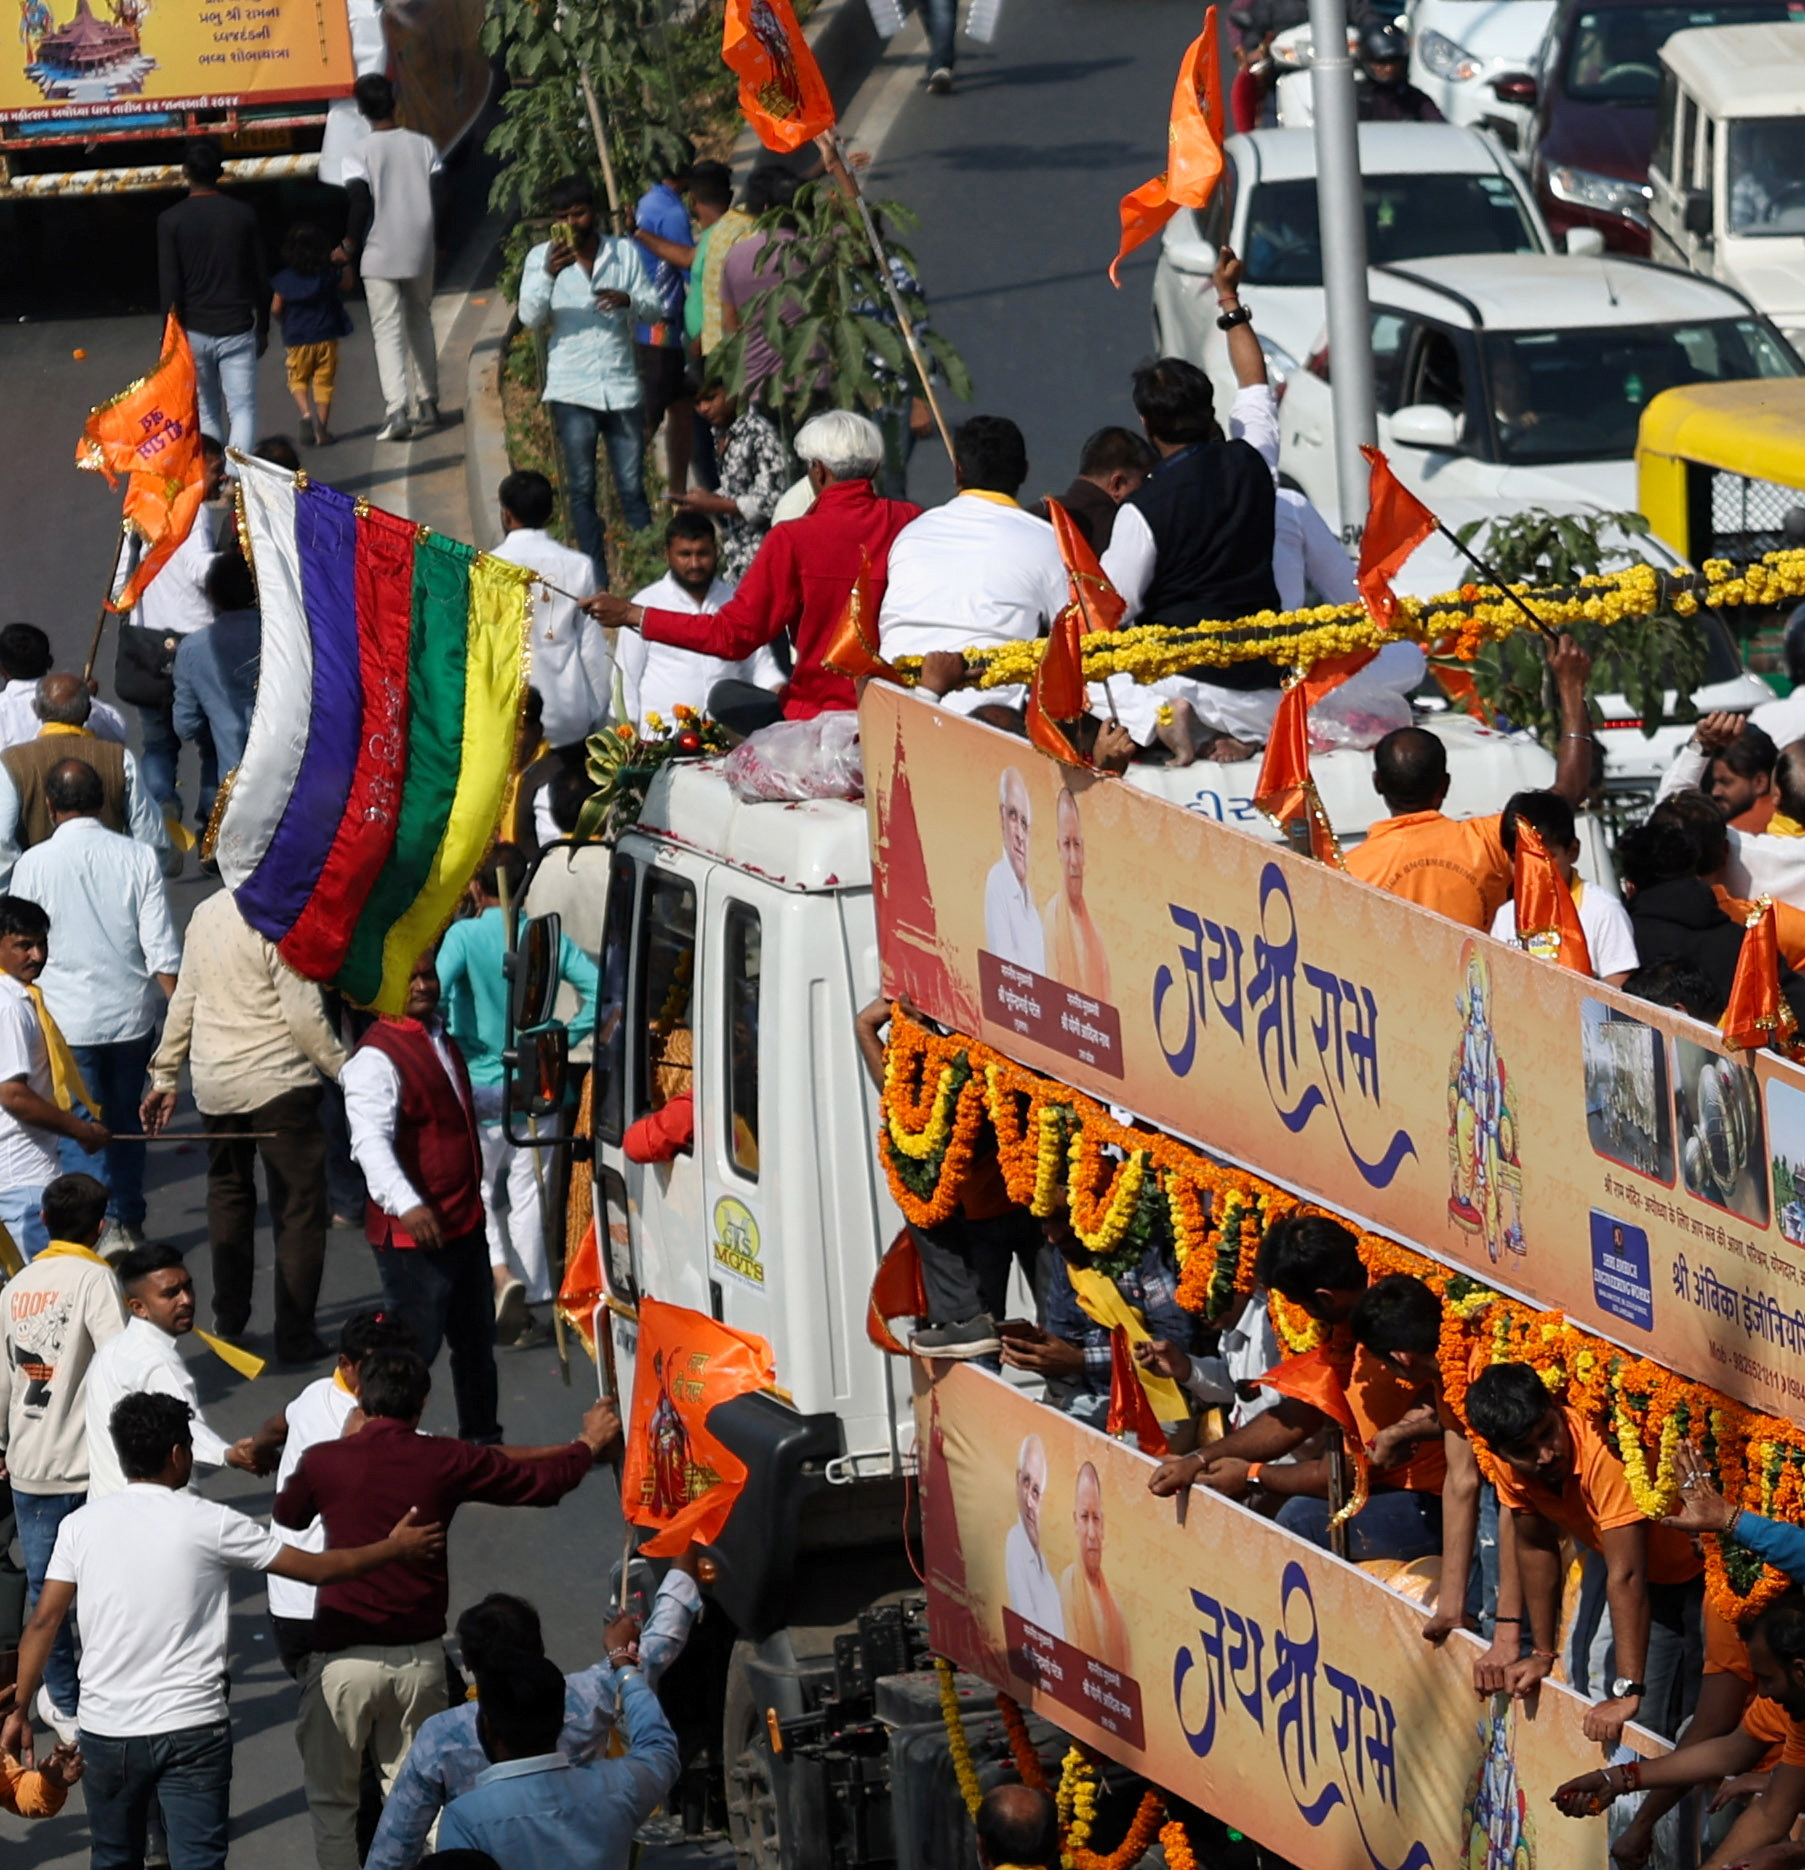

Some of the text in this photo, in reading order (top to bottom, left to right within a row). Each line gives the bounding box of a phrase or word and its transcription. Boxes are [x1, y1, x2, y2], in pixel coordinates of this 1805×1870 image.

[1151, 862, 1419, 1189] जय श्री राम
[713, 1244, 765, 1283] MGTS
[1672, 1252, 1691, 1302] श्री
[1693, 1263, 1740, 1326] अंबिका
[1173, 1588, 1264, 1757] जय
[1268, 1561, 1345, 1826] श्री
